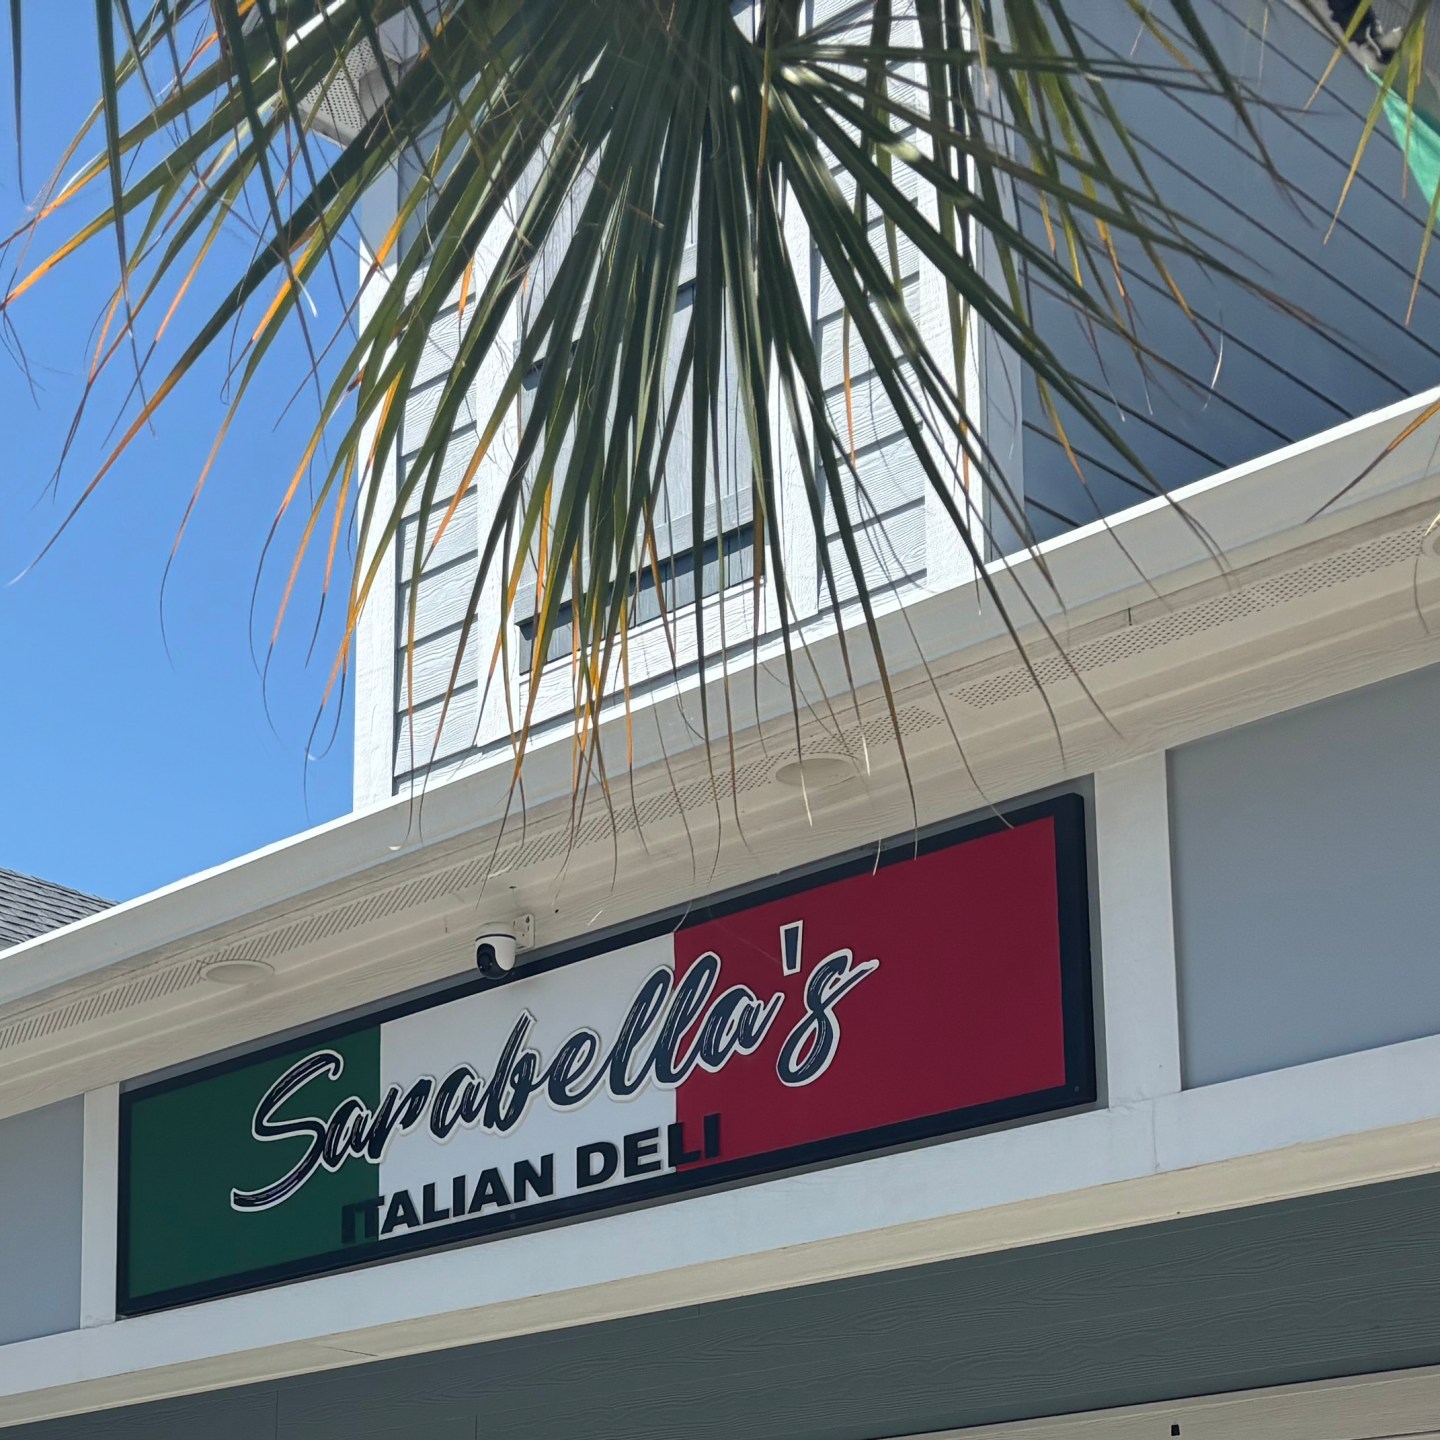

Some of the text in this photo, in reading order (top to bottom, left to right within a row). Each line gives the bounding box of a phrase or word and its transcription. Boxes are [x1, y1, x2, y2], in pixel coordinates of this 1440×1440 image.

[231, 919, 879, 1212] Sarabella's
[341, 1113, 721, 1244] ITALIAN DELI
